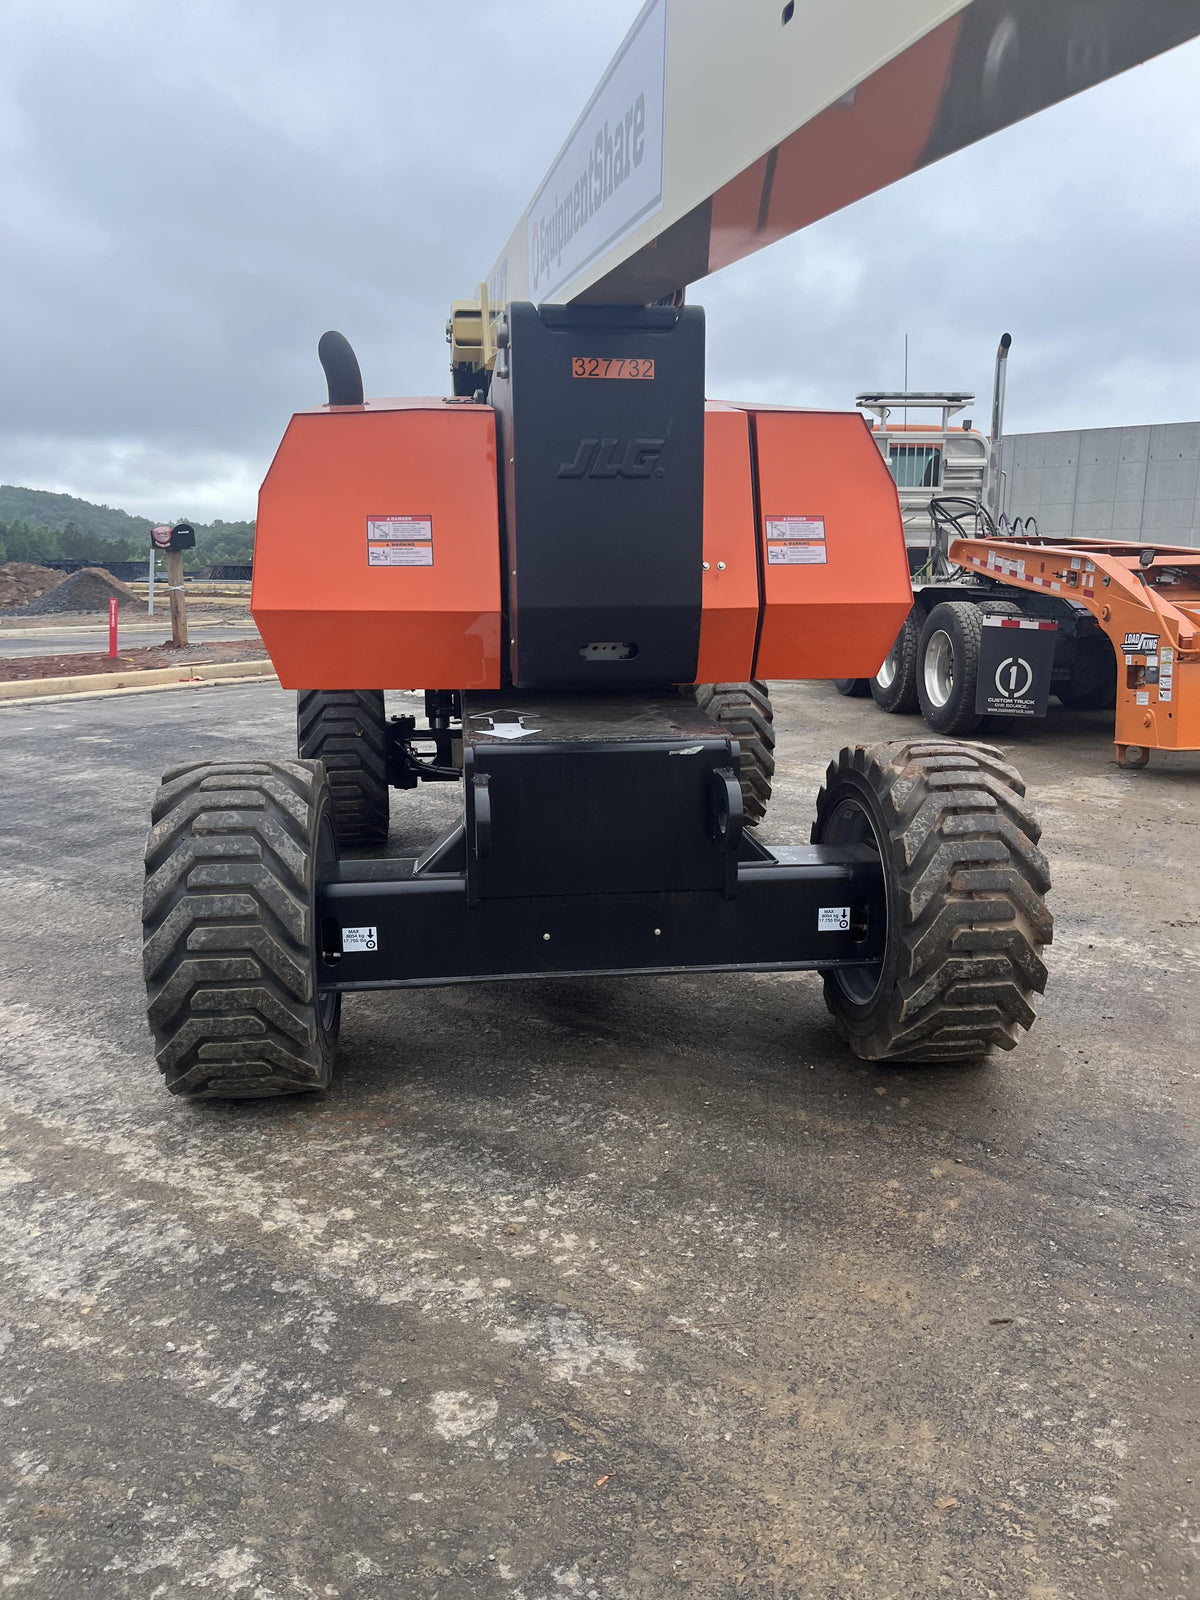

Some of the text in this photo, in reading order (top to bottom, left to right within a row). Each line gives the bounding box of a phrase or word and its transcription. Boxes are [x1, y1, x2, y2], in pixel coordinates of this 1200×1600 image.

[539, 91, 645, 281] EquipmentShare
[574, 358, 653, 378] 327732
[1125, 634, 1158, 650] LOAD KING
